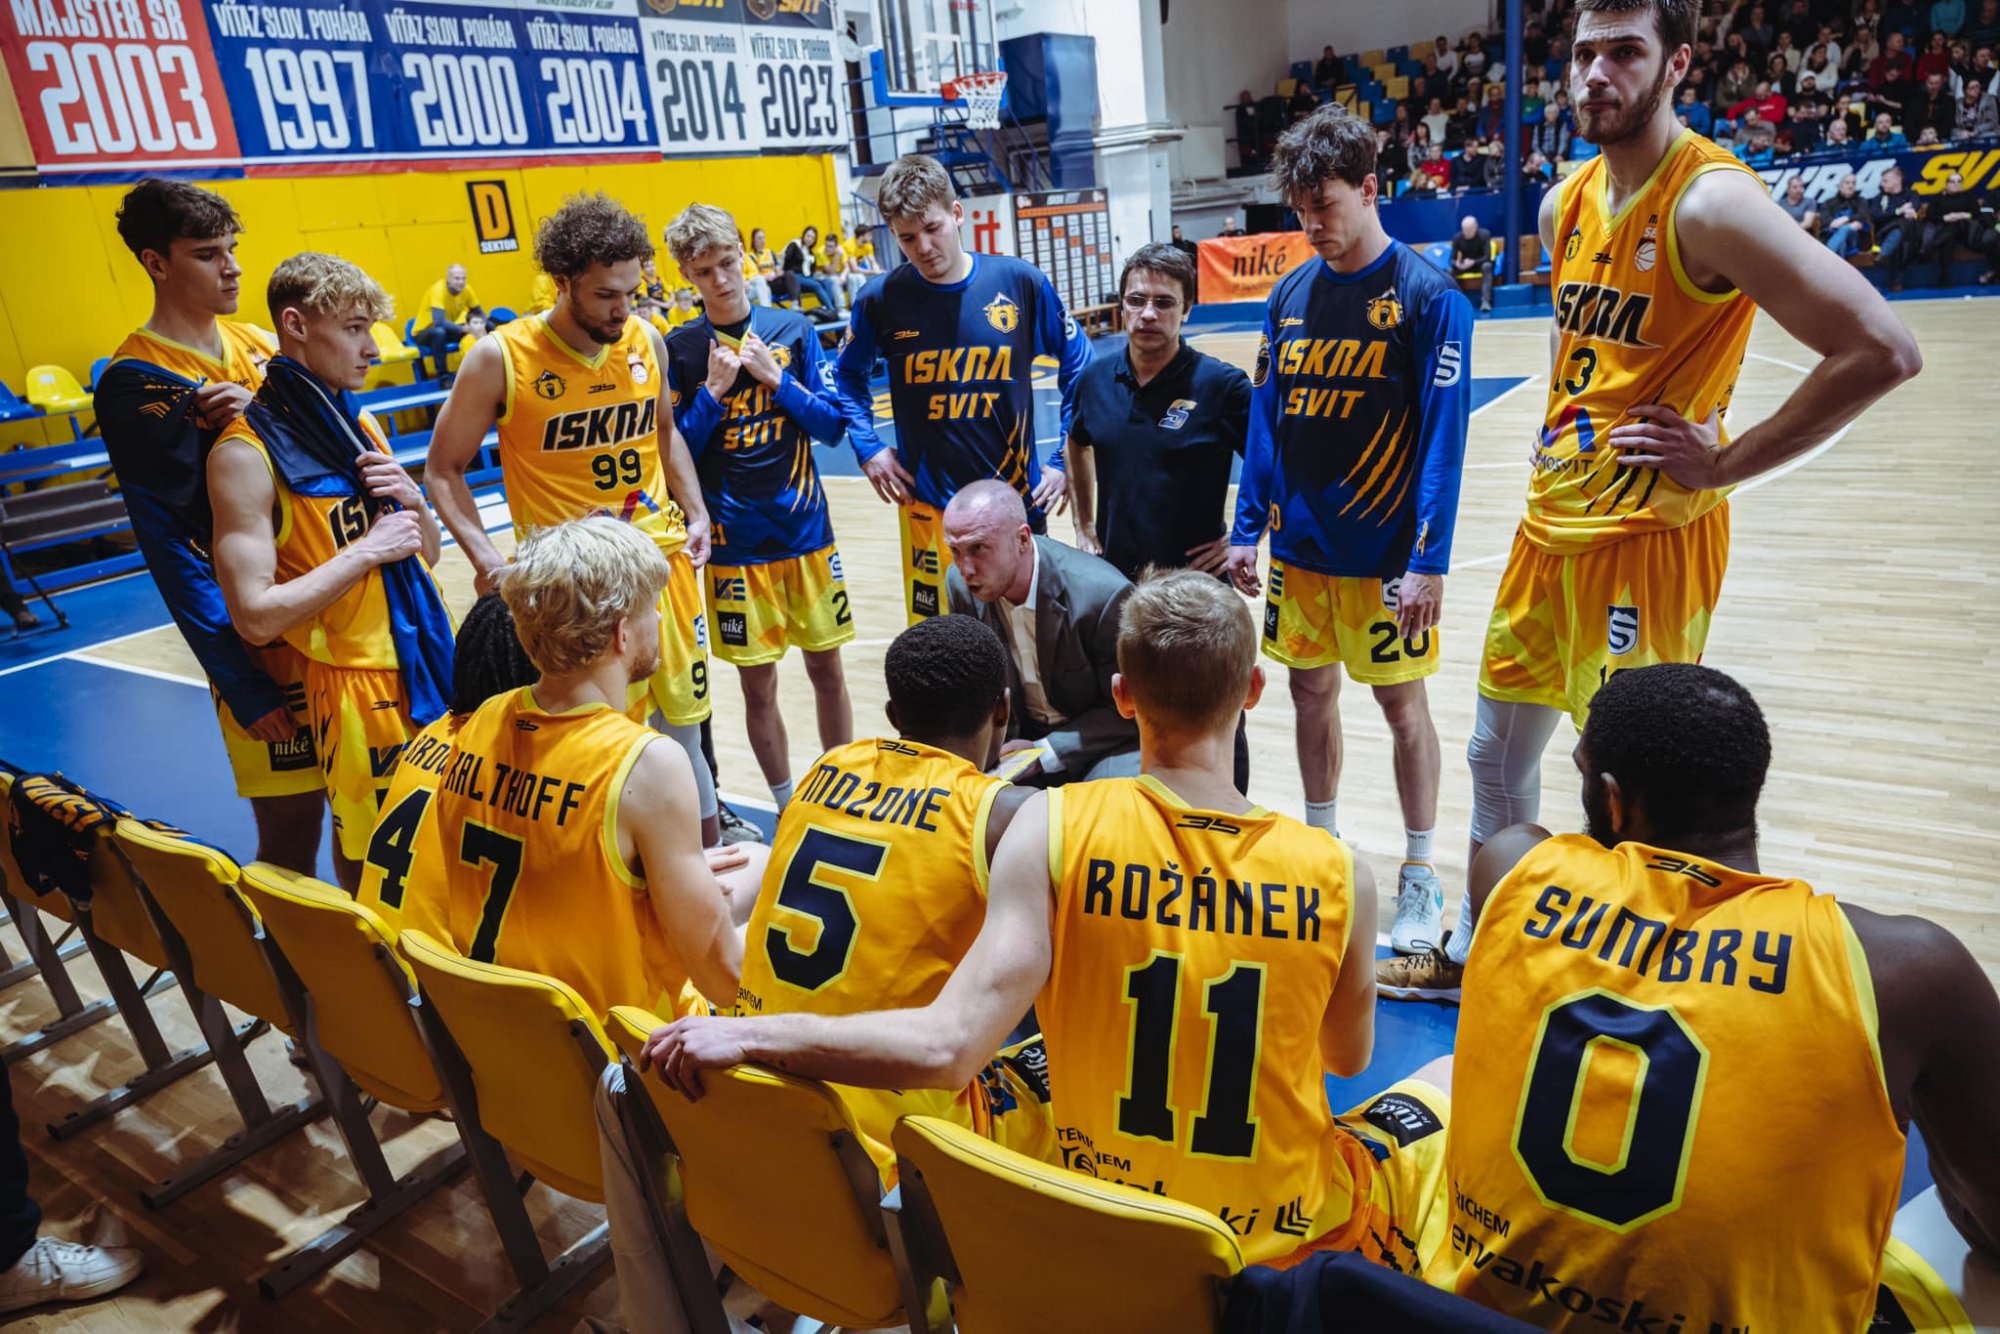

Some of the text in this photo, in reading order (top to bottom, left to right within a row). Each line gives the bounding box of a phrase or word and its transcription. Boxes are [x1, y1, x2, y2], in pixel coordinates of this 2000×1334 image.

[149, 0, 188, 40] SR
[261, 6, 309, 39] SLOV.
[307, 4, 372, 42] POHÁRA
[423, 15, 464, 46] SLOV.
[462, 14, 517, 49] POHÁRA
[561, 23, 595, 52] SLOV.
[592, 21, 639, 54] POHÁRA
[27, 41, 218, 156] 2003
[245, 47, 375, 150] 1997
[403, 53, 528, 146] 2000
[539, 57, 649, 144] 2004
[657, 58, 747, 142] 2014
[757, 63, 838, 137] 2023
[472, 183, 511, 240] D
[480, 238, 519, 254] SEKTOR
[1232, 243, 1287, 277] niké
[905, 345, 1014, 385] ISKRA
[1278, 338, 1388, 379] ISKRA
[541, 396, 657, 454] ISKRA
[927, 392, 1000, 420] SVIT
[1285, 387, 1366, 419] SVIT
[722, 416, 787, 450] SVIT
[591, 448, 643, 491] 99
[915, 590, 936, 607] niké
[720, 618, 744, 635] niké
[1369, 620, 1430, 664] 20
[274, 734, 310, 755] niké
[445, 751, 586, 827] KALTHOFF
[366, 786, 434, 910] 4
[459, 818, 526, 965] 7
[764, 824, 892, 994] 5
[1084, 858, 1321, 943] ROŽÁNEK
[1115, 951, 1266, 1161] 11
[1512, 988, 1709, 1232] 0
[1452, 1223, 1687, 1334] ervakoski
